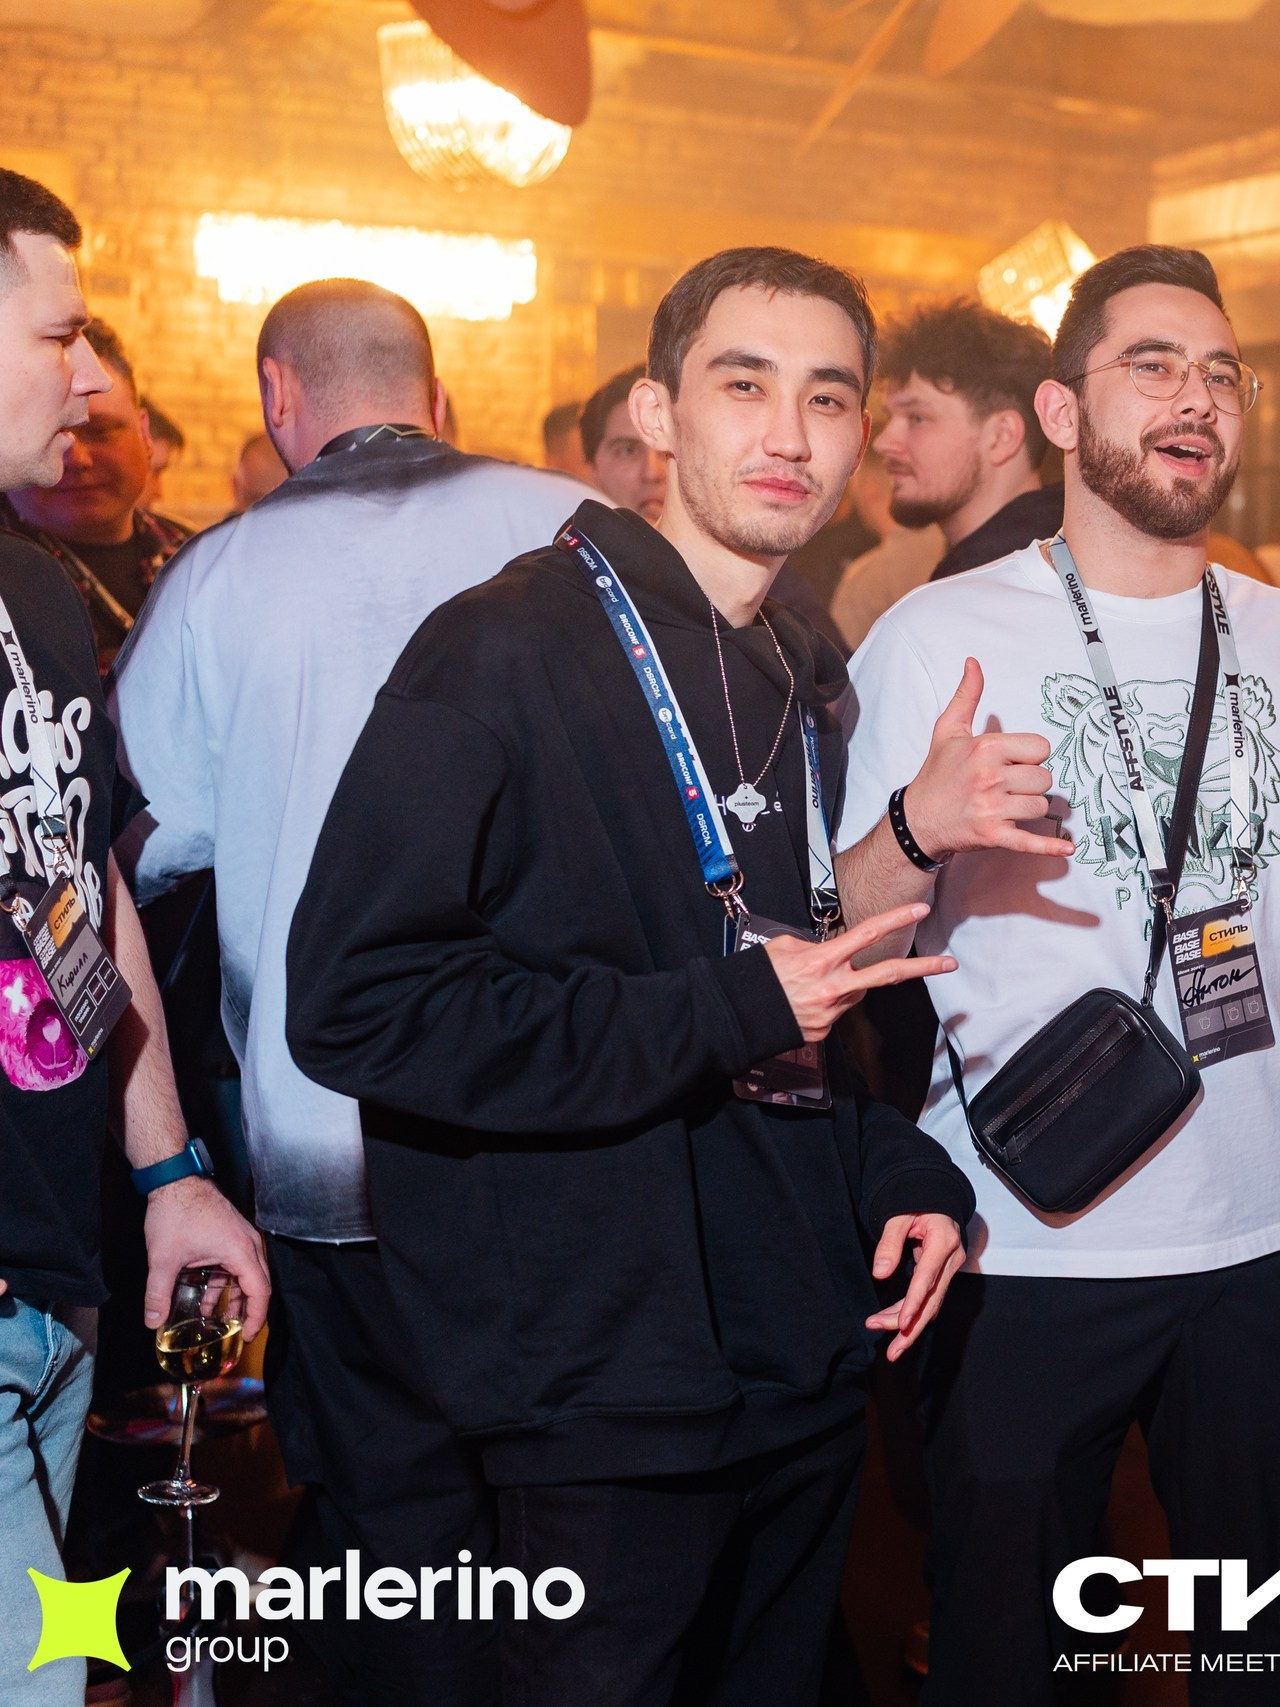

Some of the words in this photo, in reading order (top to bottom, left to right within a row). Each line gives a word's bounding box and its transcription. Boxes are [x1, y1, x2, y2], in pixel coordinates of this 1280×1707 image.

[1065, 572, 1093, 625] marlerino
[619, 614, 640, 645] BROCONF
[10, 651, 39, 724] marlerino
[1102, 686, 1145, 793] AFFSTYLE
[1229, 691, 1244, 758] marlerino
[676, 752, 694, 786] BROCONF
[54, 897, 76, 930] СТИЛЬ
[1173, 927, 1200, 945] BASE
[1174, 938, 1201, 955] BASE
[1208, 924, 1249, 942] СТИЛЬ
[1175, 948, 1202, 965] BASE
